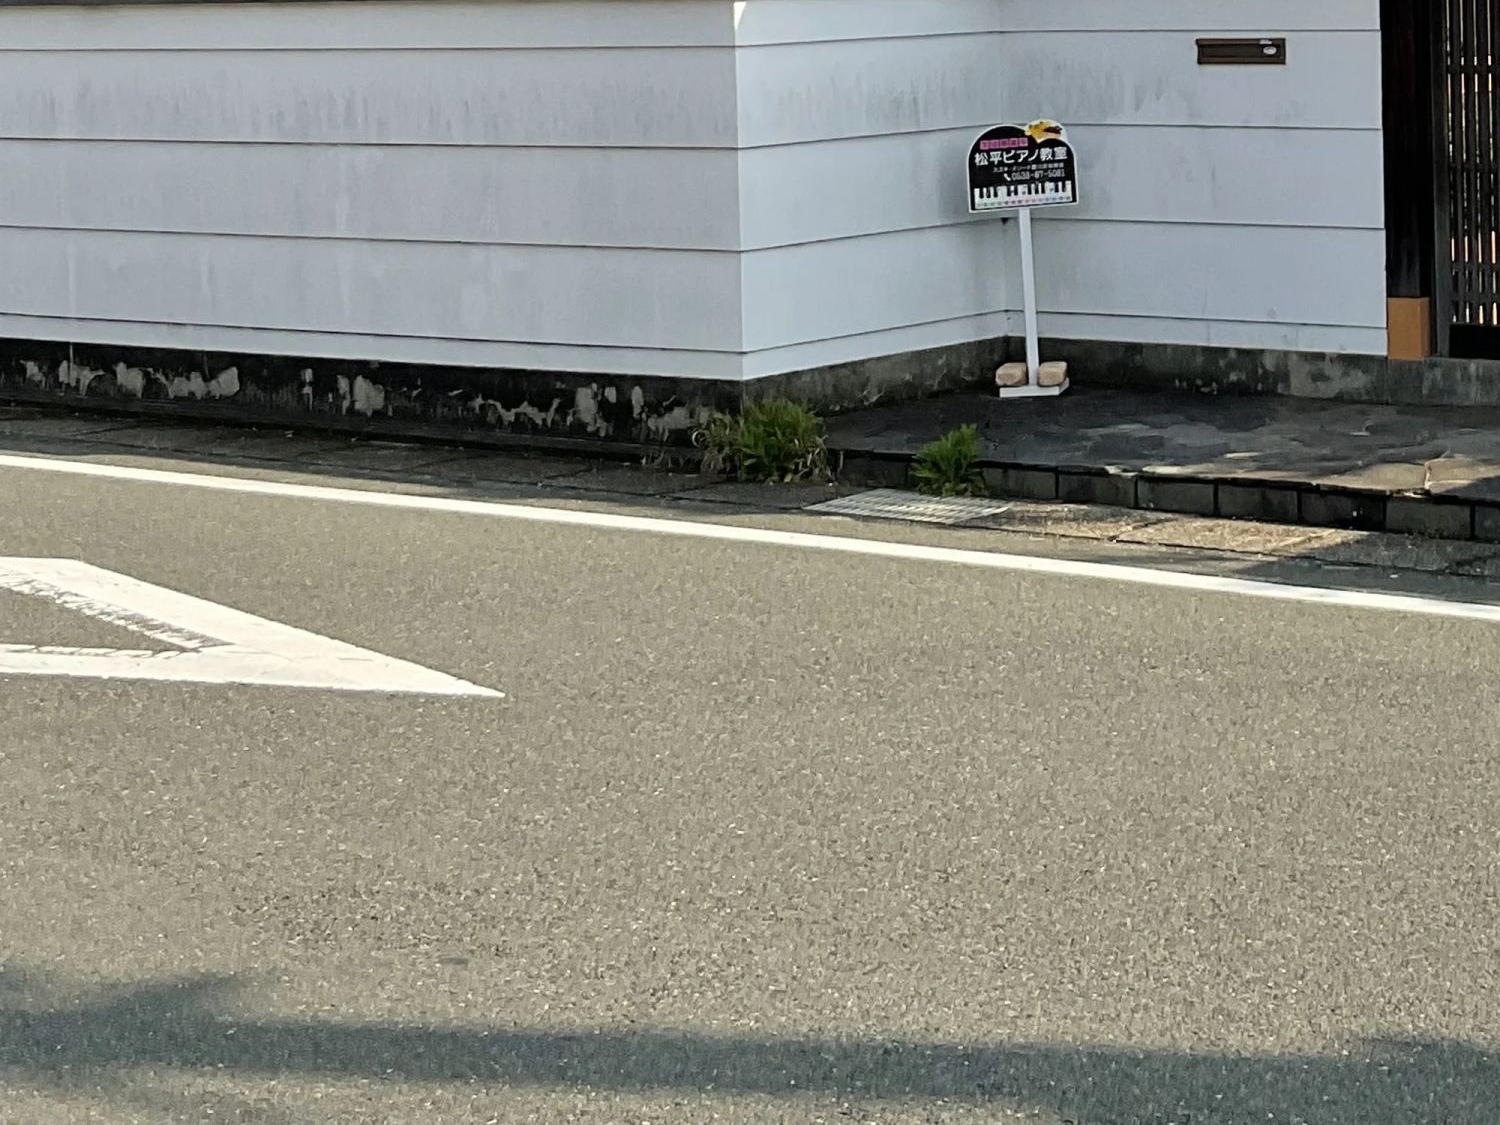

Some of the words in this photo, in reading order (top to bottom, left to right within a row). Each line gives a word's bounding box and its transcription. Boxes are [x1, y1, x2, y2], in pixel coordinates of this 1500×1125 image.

[974, 146, 1068, 166] 松平ピアノ教室
